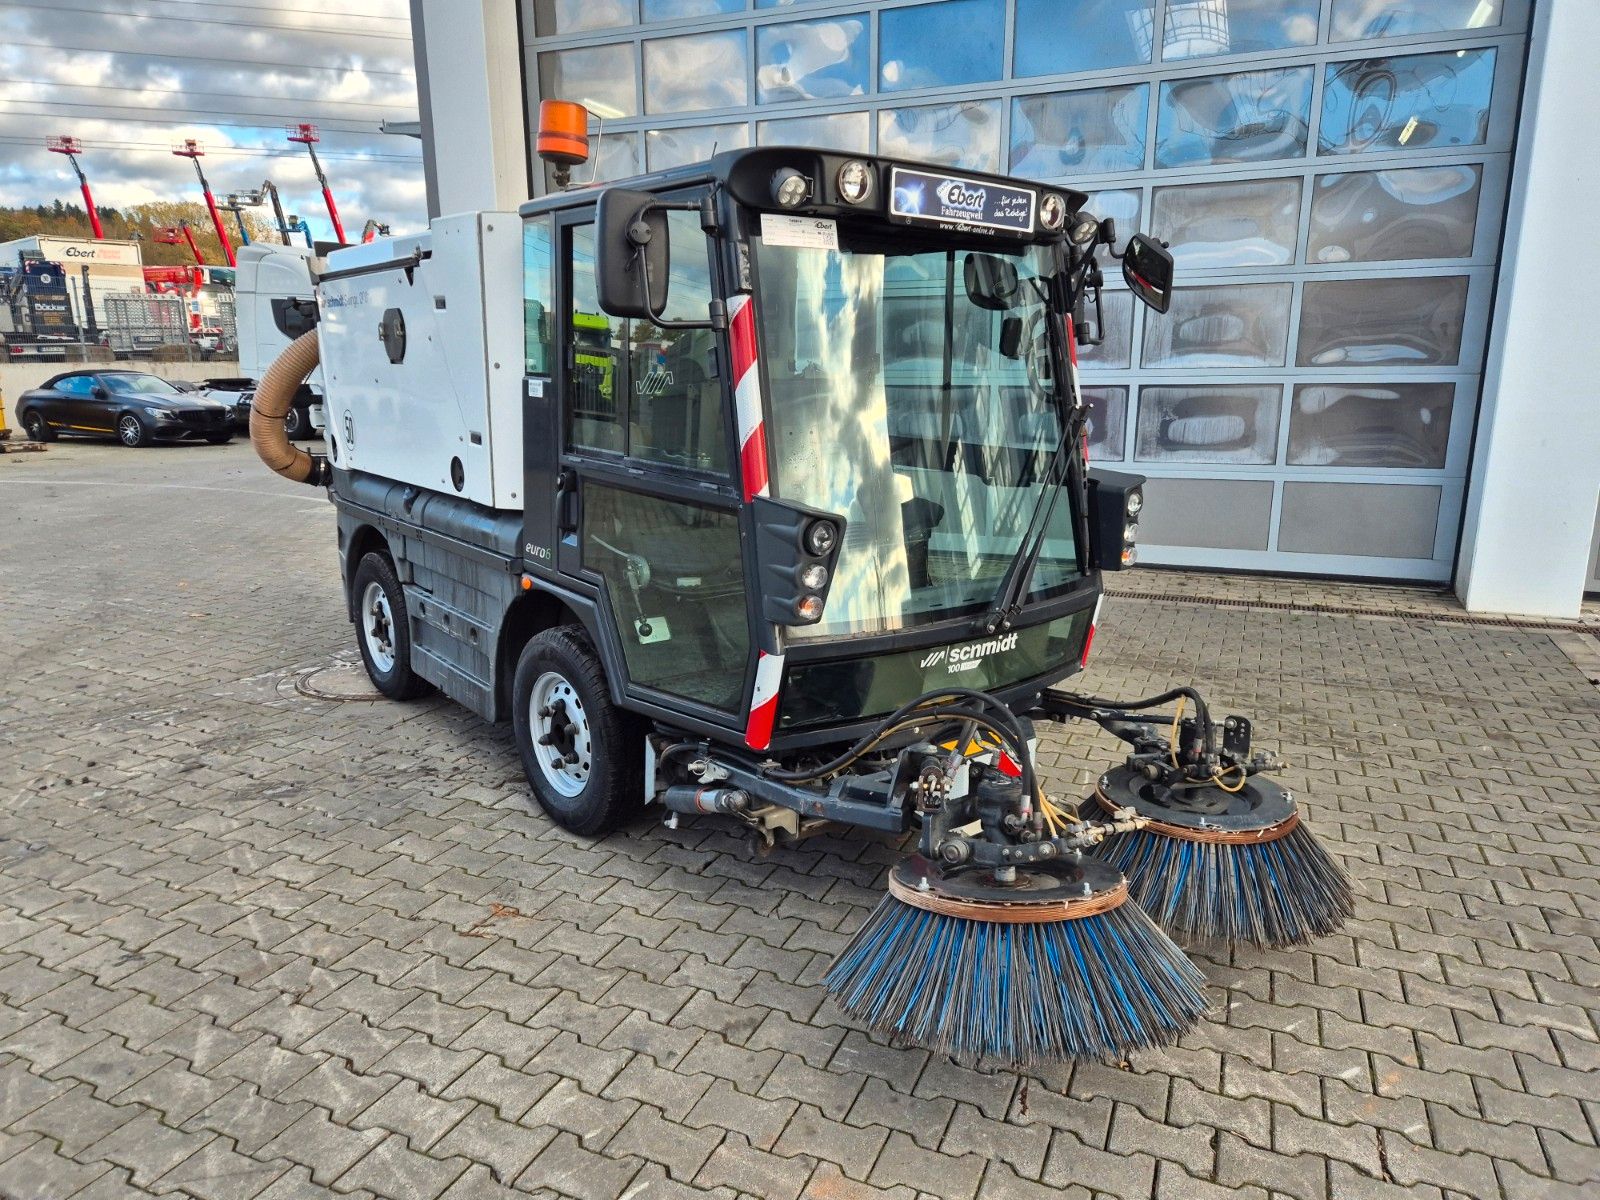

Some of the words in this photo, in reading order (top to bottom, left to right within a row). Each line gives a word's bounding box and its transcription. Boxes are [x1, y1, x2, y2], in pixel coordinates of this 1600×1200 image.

[948, 184, 985, 208] Ebert
[941, 205, 983, 220] Fahrzeugwelt
[815, 221, 833, 230] Ebert
[66, 247, 96, 258] Ebert
[525, 542, 551, 560] euro6
[948, 663, 961, 674] 100
